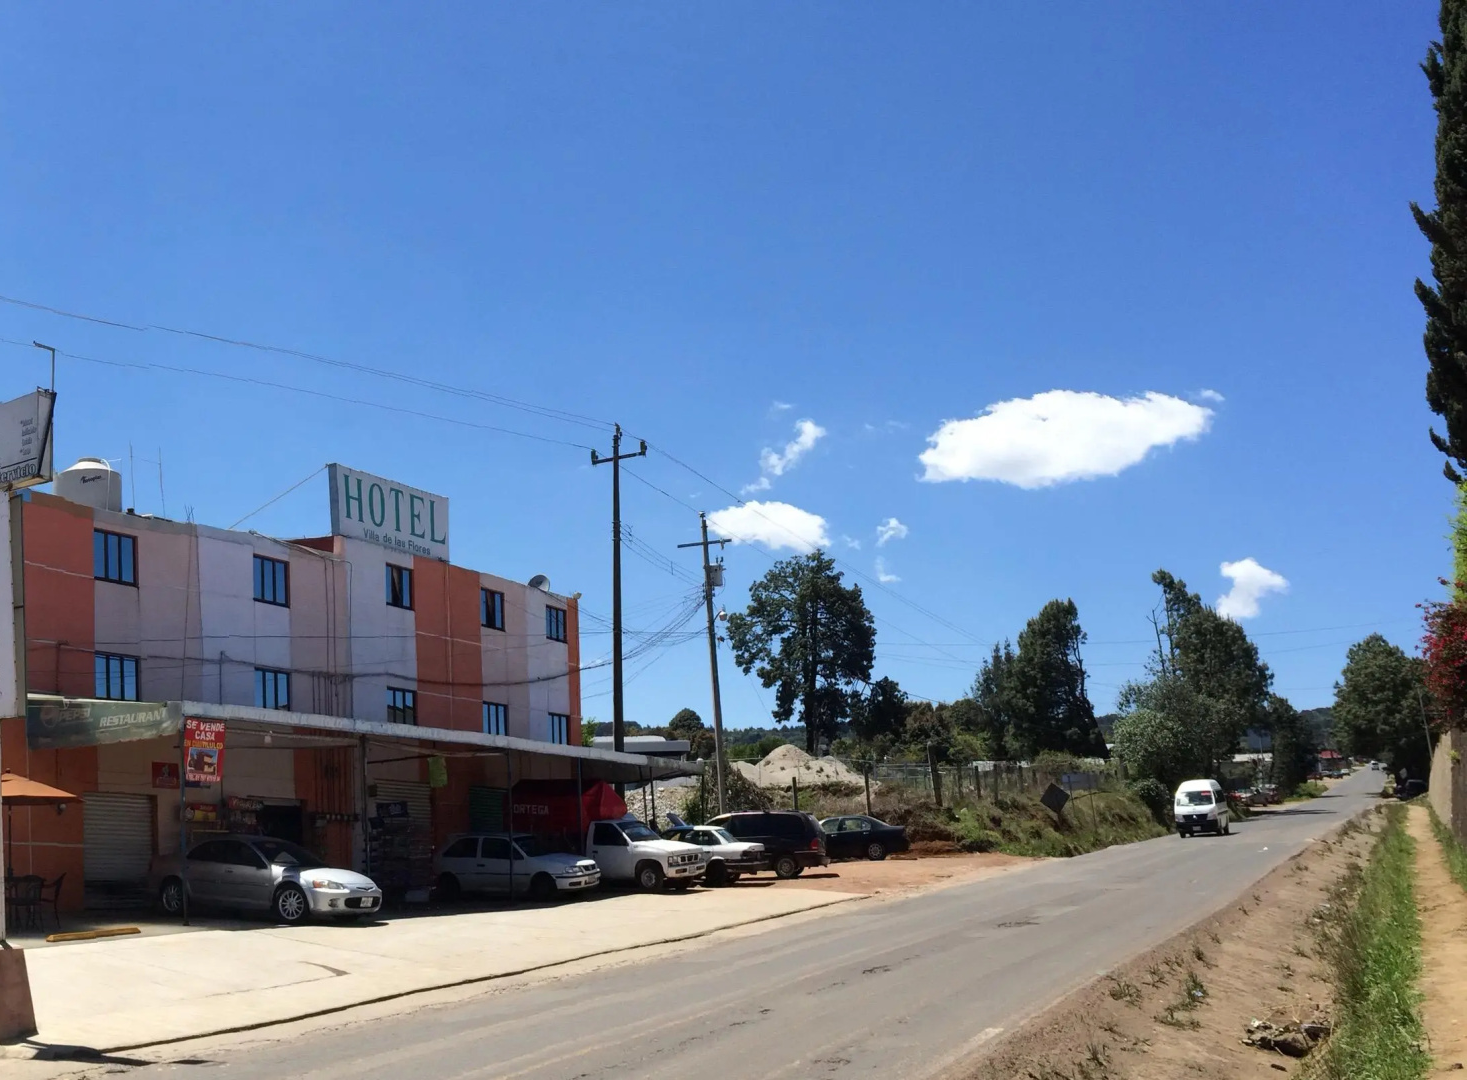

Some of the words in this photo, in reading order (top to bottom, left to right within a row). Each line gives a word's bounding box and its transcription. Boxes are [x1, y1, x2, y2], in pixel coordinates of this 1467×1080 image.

[343, 473, 447, 545] HOTEL
[363, 527, 380, 542] Villa
[383, 532, 393, 544] de
[394, 536, 406, 548] las
[407, 540, 431, 556] Flores
[58, 708, 91, 721] PEPSI
[99, 707, 169, 728] RESTAURANT
[186, 719, 198, 729] SE
[200, 722, 225, 732] VENDE
[194, 730, 215, 741] CASA
[513, 804, 549, 815] ORTEGA
